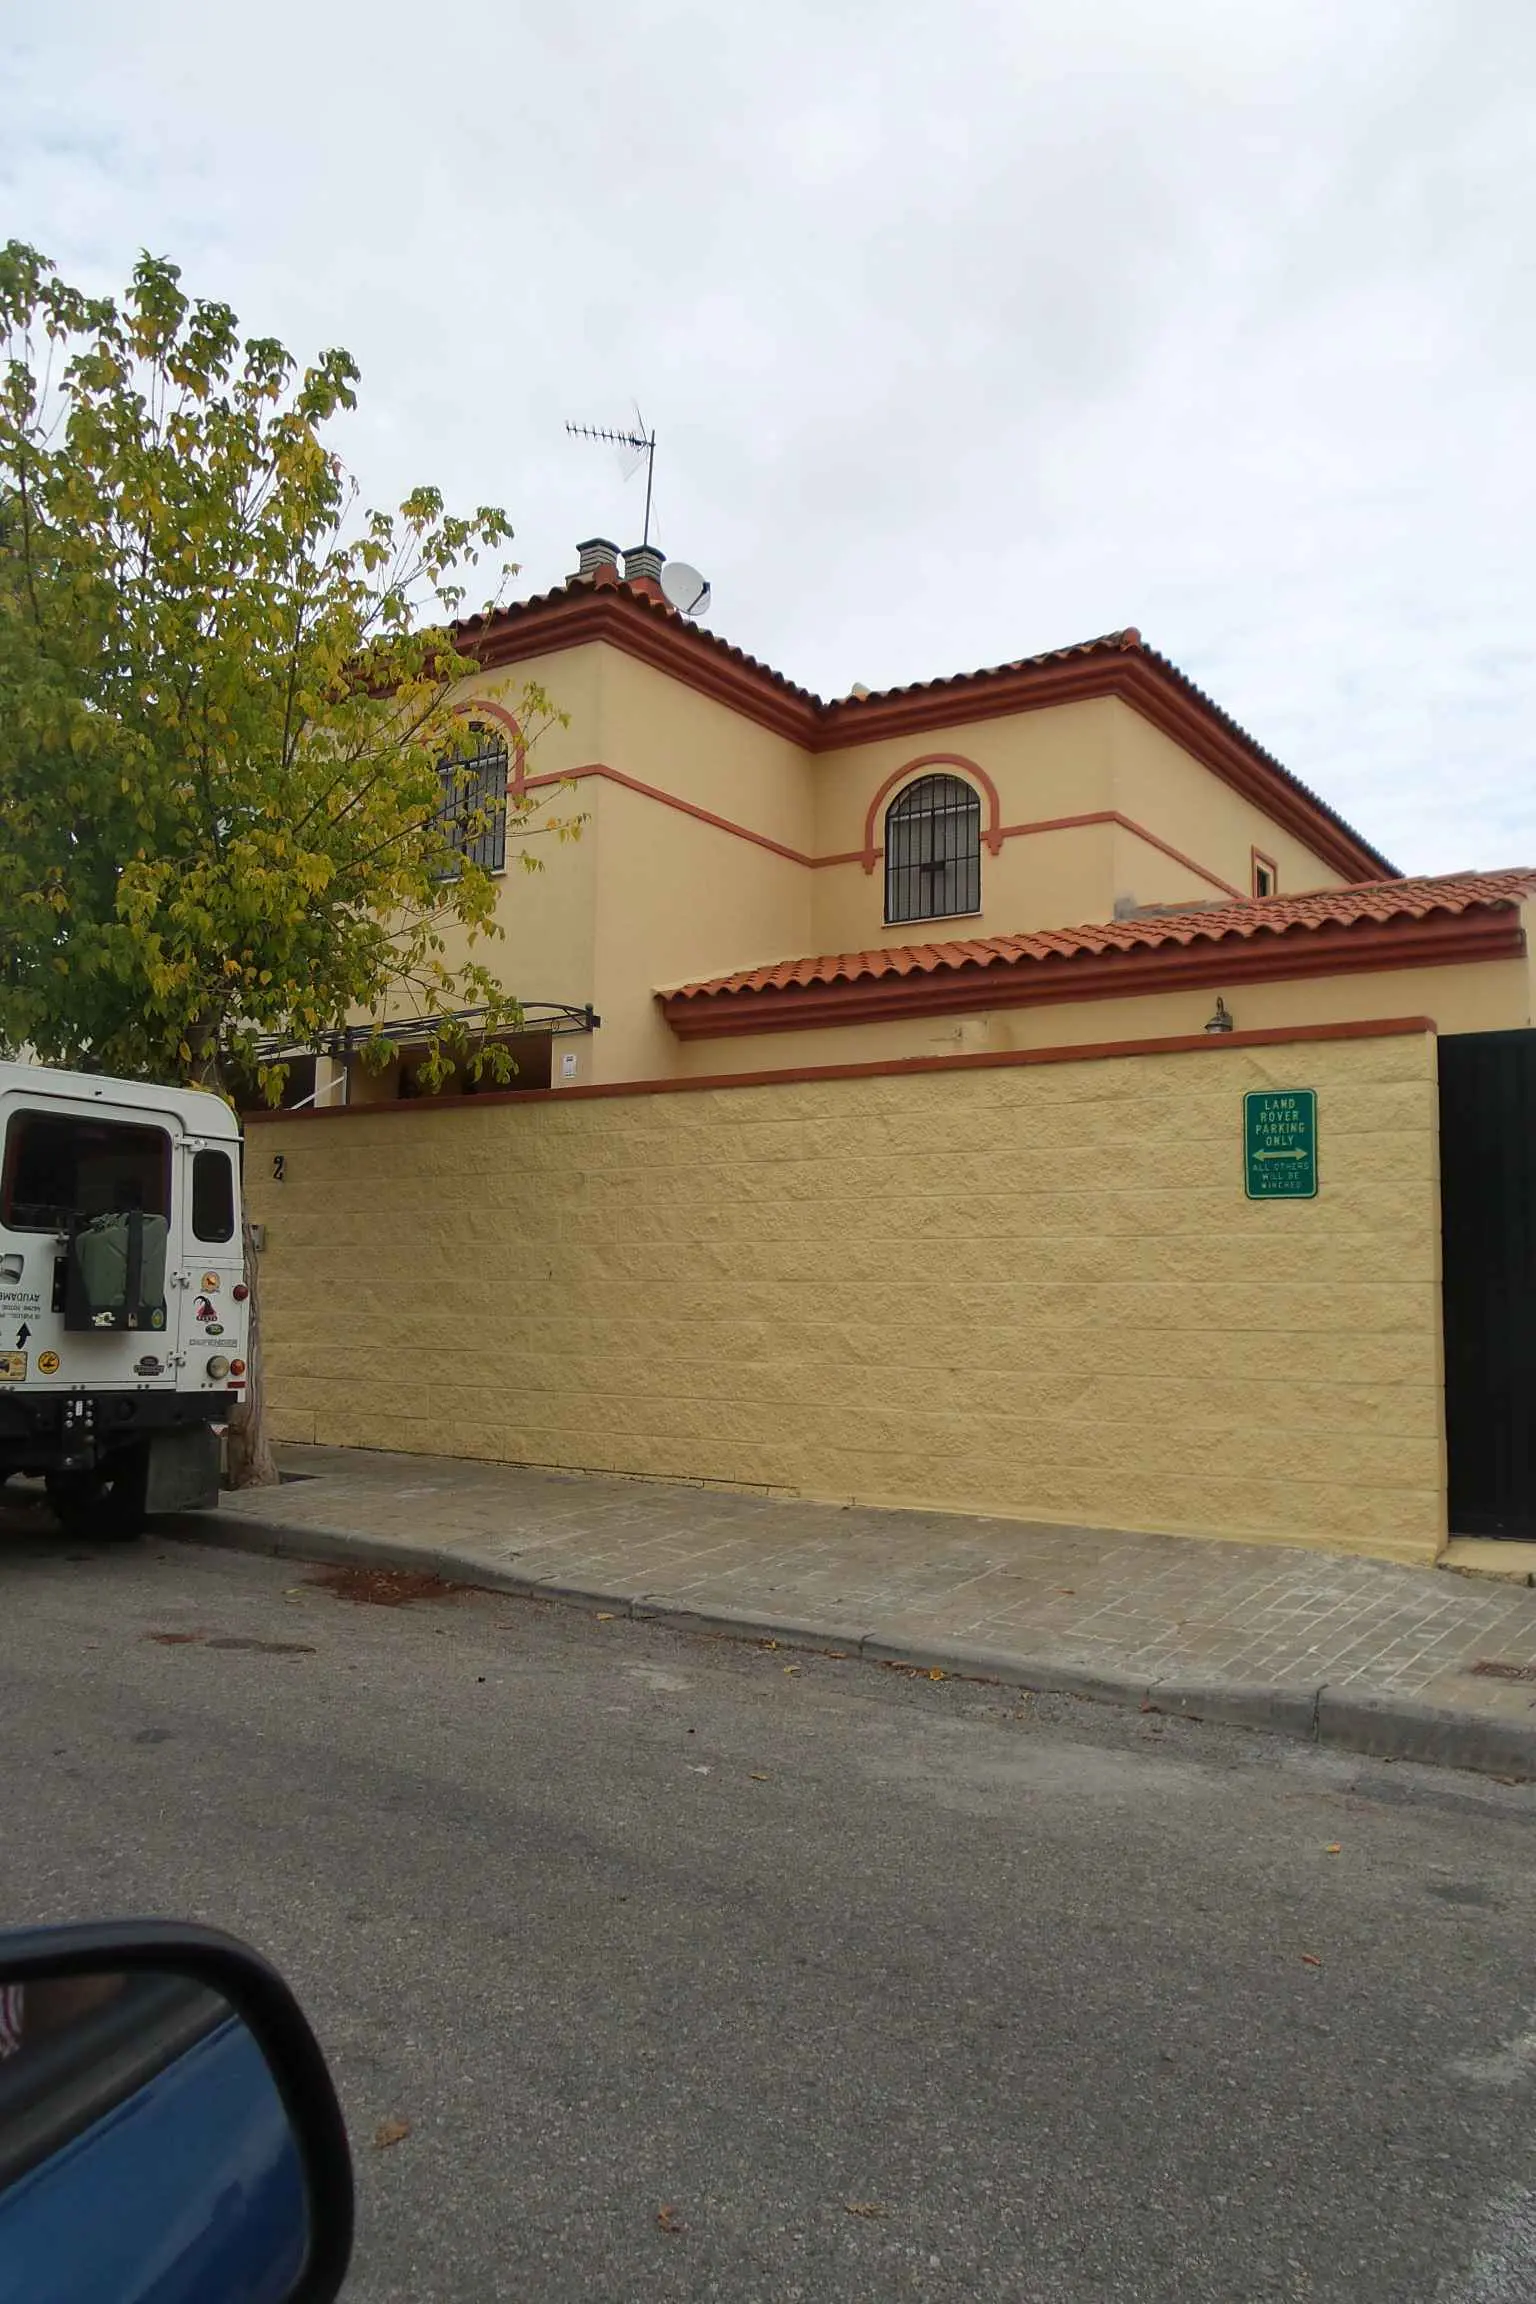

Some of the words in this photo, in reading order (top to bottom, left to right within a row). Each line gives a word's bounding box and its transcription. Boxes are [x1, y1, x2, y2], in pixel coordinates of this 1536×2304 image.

[1264, 1098, 1296, 1110] LAND
[1260, 1110, 1300, 1122] ROVER
[1255, 1122, 1305, 1135] PARKING
[1266, 1135, 1294, 1146] ONLY
[273, 1155, 285, 1181] 2
[1253, 1163, 1270, 1172] ALL
[1273, 1162, 1310, 1171] OTHERS
[1262, 1172, 1284, 1181] WILL
[1287, 1171, 1300, 1180] BE
